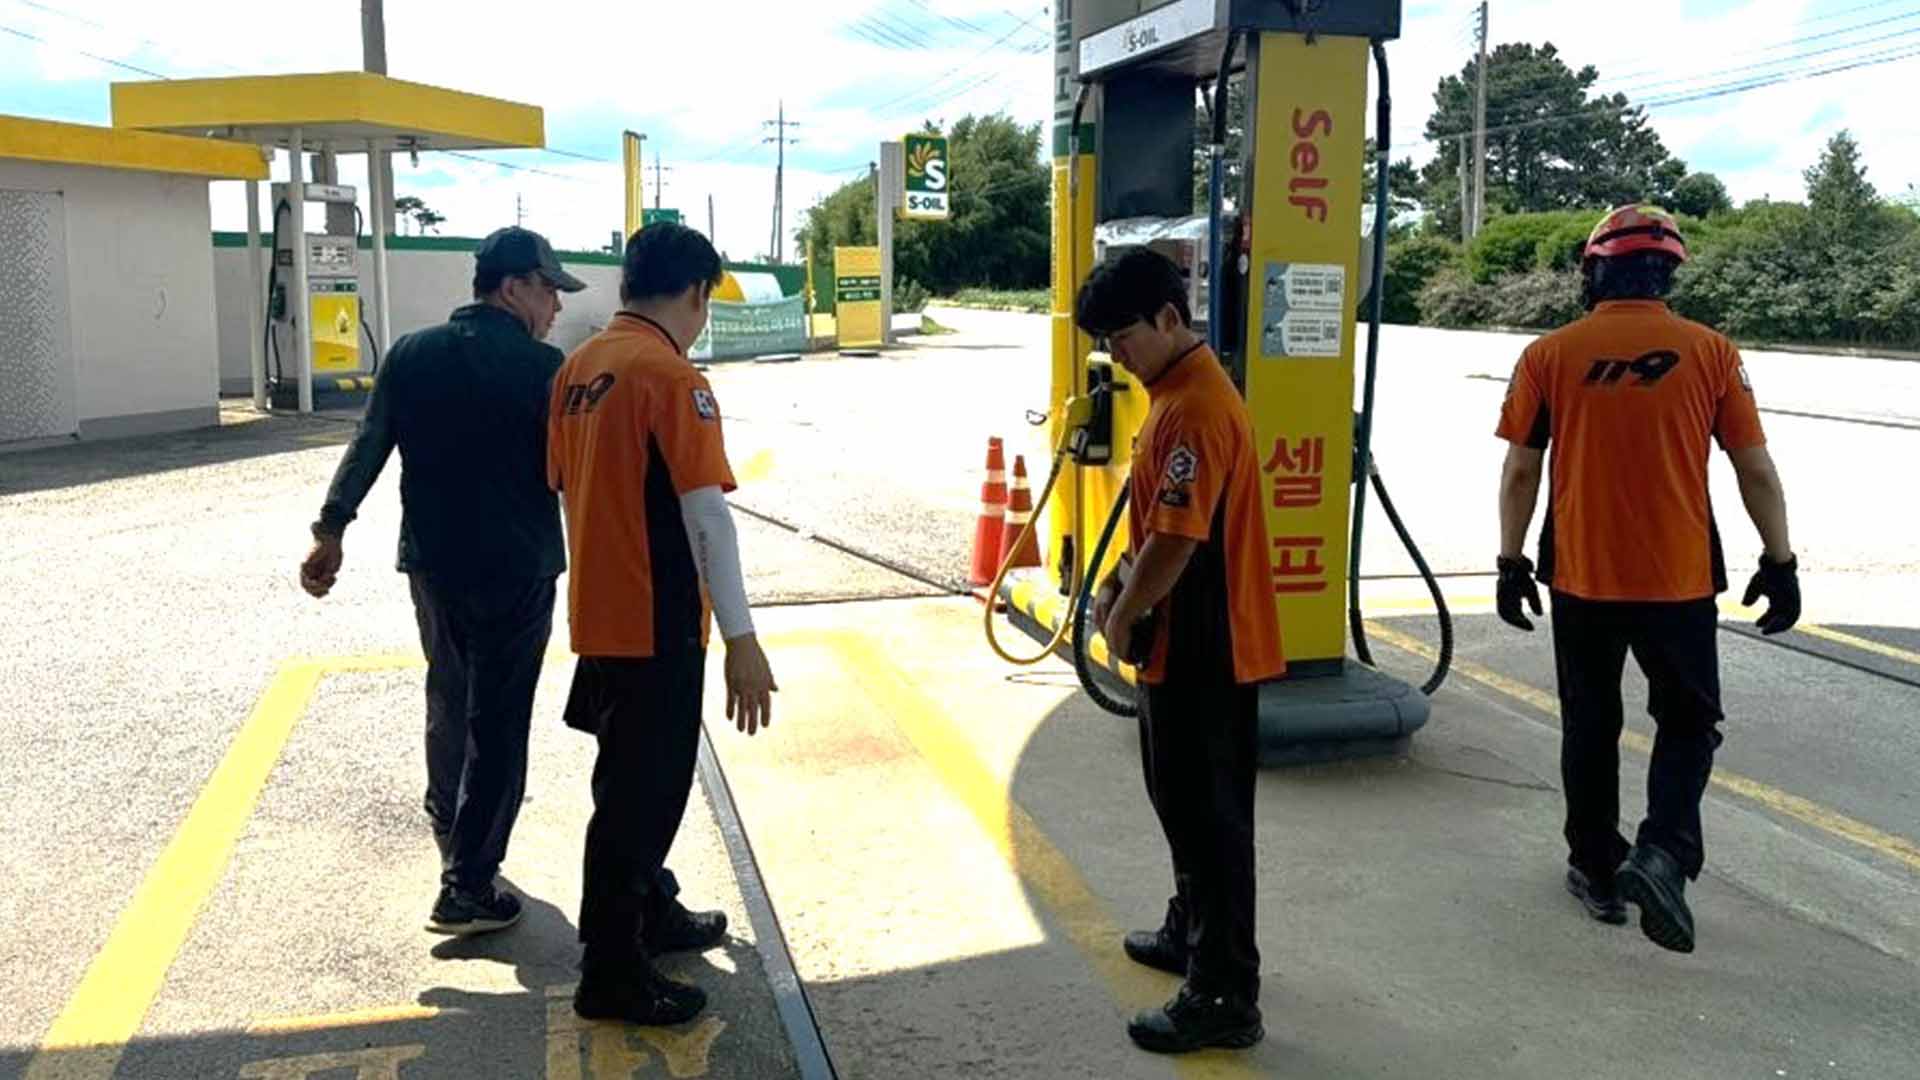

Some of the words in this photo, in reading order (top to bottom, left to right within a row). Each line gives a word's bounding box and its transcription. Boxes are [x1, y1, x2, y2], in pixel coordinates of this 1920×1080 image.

[1128, 27, 1159, 52] S-OIL
[908, 195, 945, 210] S-OIL
[1583, 350, 1681, 386] 119
[564, 372, 616, 415] 119
[1264, 437, 1328, 593] 셀프
